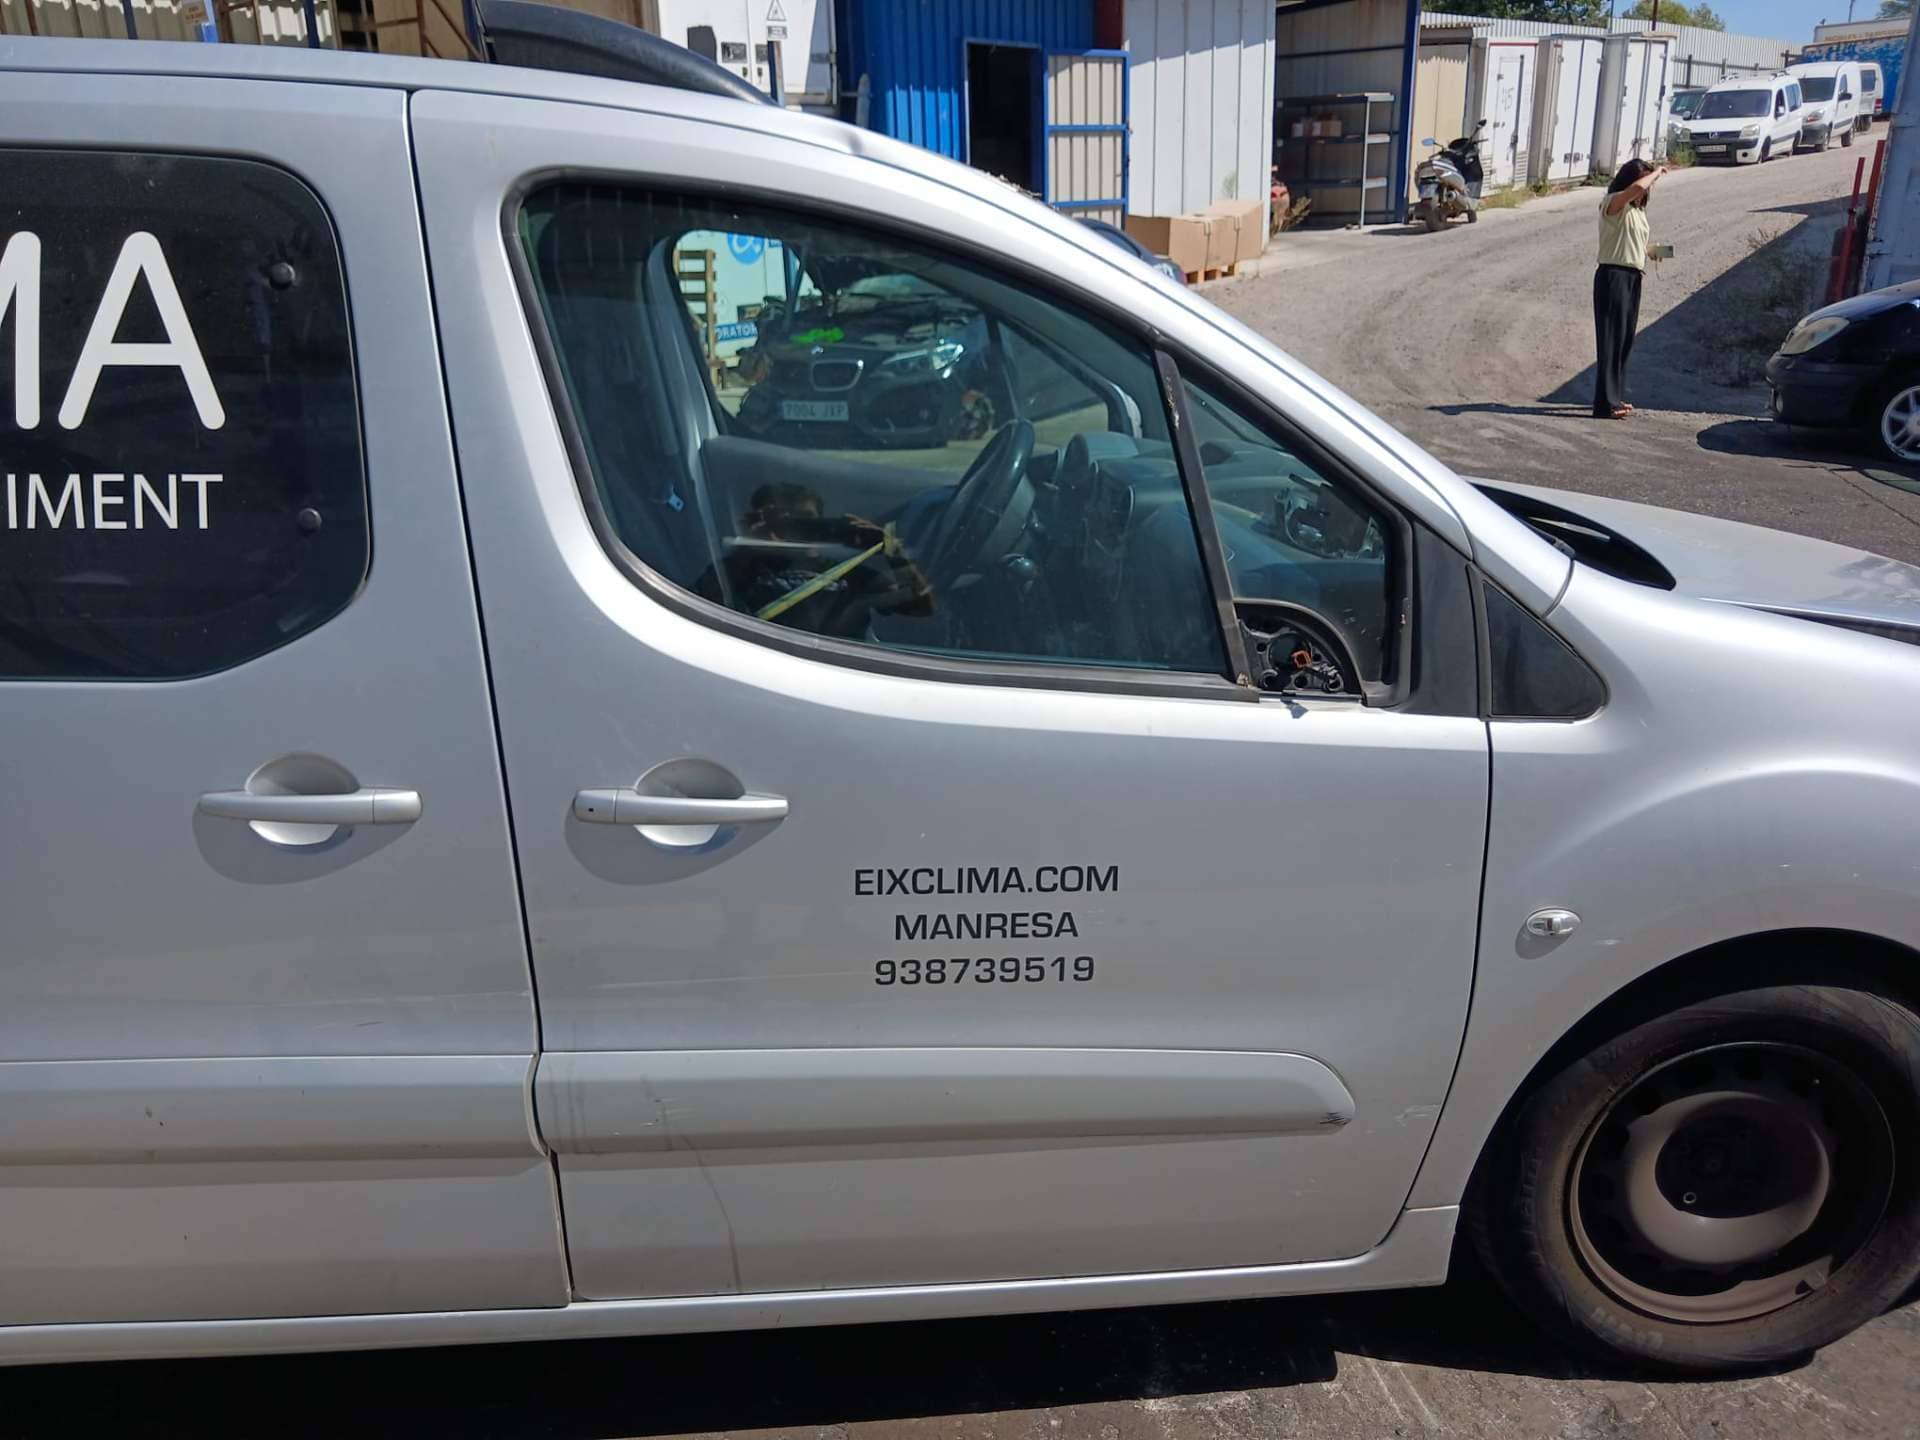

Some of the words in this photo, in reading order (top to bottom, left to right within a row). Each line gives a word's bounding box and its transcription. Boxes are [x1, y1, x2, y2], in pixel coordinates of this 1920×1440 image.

[6, 473, 224, 530] IMENT
[854, 865, 1119, 896] EIXCLIMA.COM
[895, 911, 1079, 941] MANRESA
[874, 956, 1095, 986] 938739519
